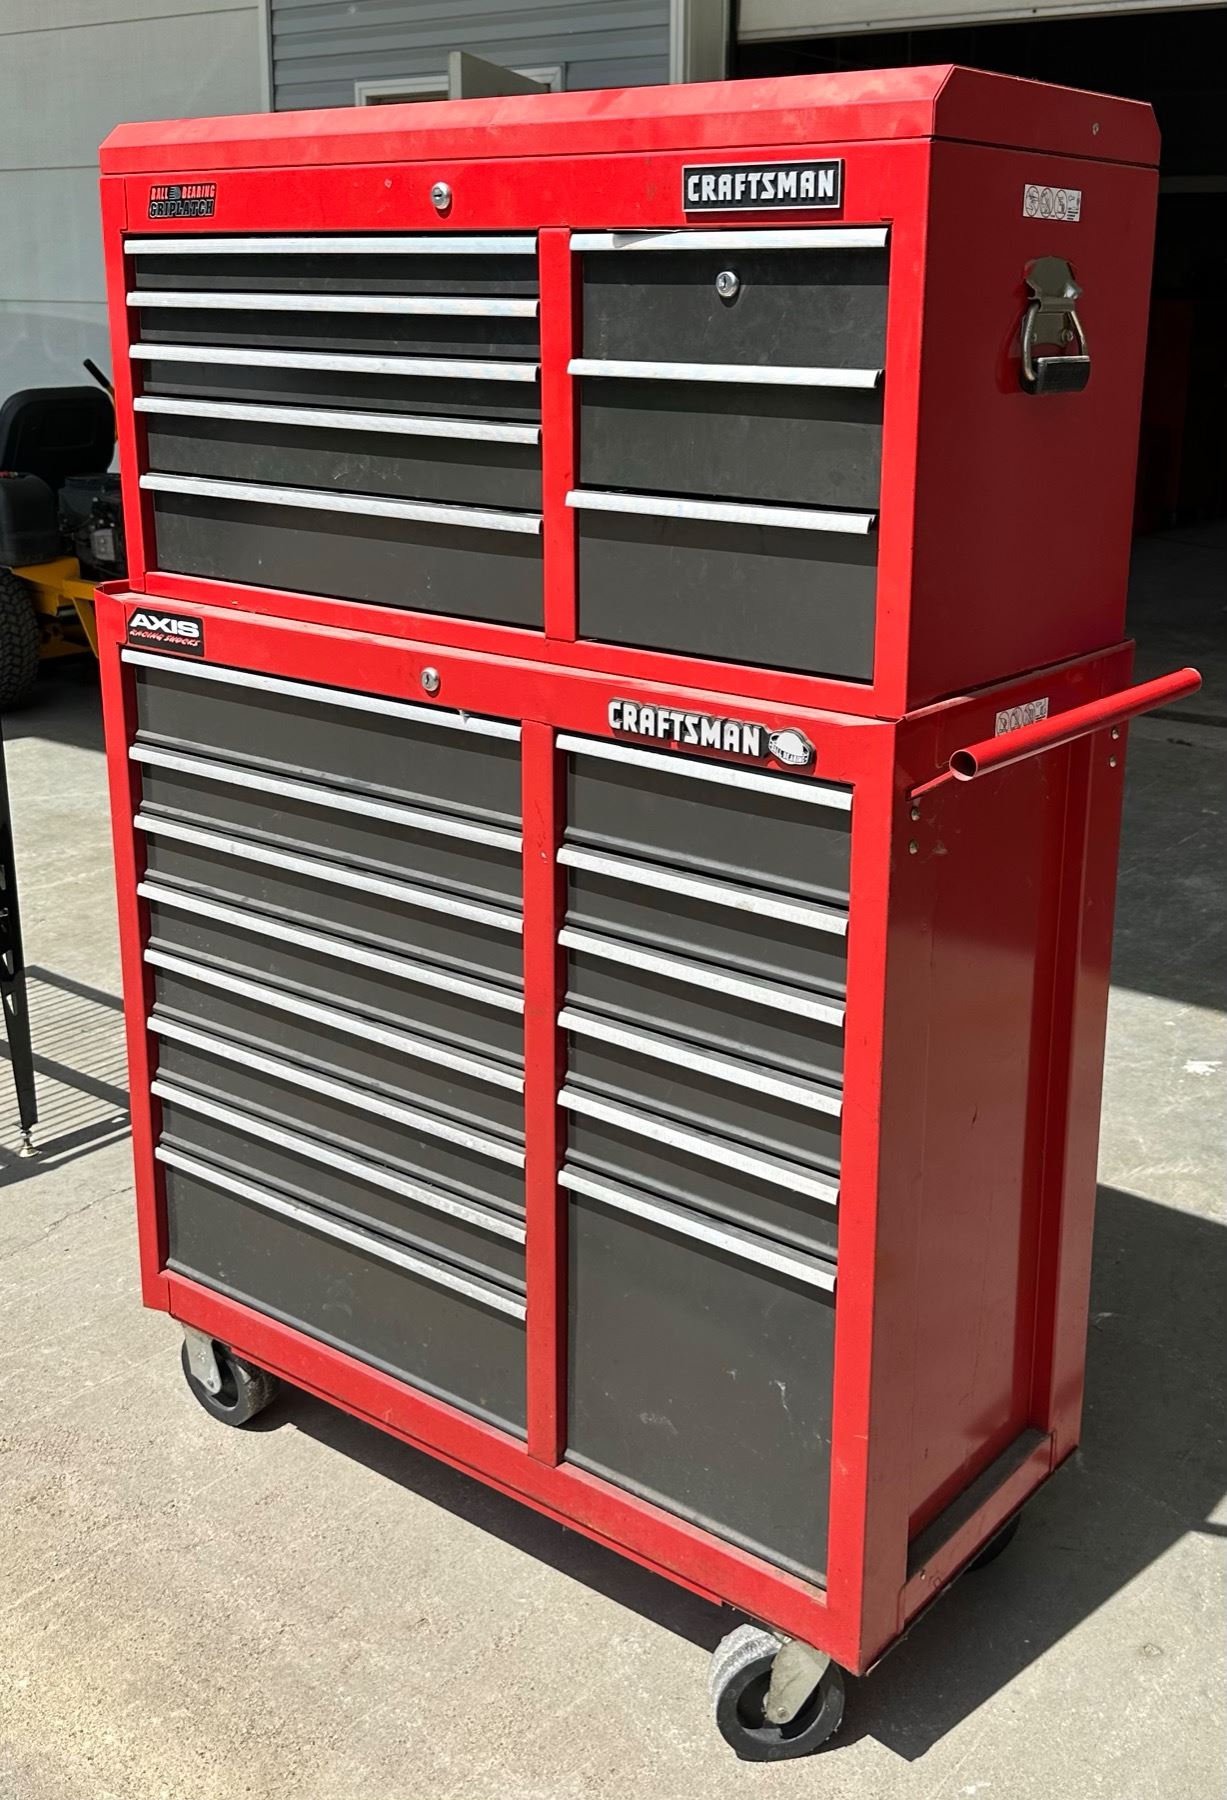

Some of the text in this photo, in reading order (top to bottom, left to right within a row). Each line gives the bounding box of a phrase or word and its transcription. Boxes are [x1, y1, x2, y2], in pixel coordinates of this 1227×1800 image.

[151, 185, 215, 200] BALL BEARING
[688, 170, 835, 202] CRAFTSMAN
[150, 200, 214, 218] GRIPLATCH
[129, 629, 164, 641] RACING
[130, 613, 200, 638] AXIS
[608, 701, 760, 756] CRAFTSMAN
